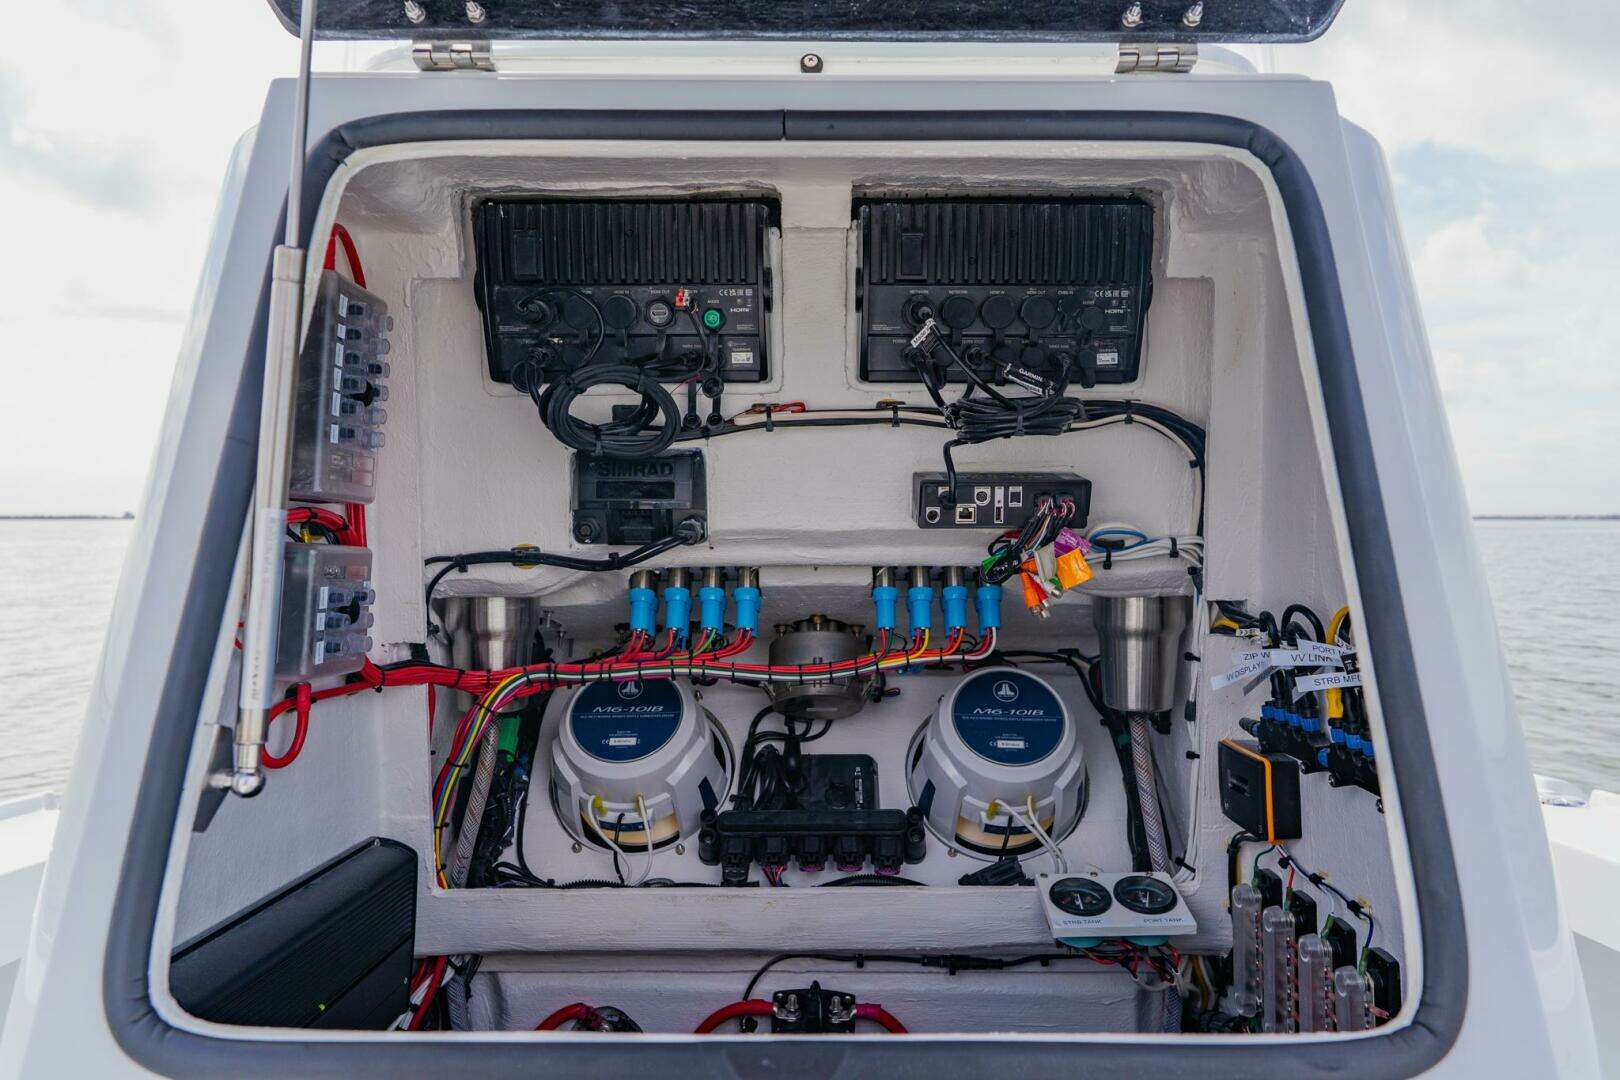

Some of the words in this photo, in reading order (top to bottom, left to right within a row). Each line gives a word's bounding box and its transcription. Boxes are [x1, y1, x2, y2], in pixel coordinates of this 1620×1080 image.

[1018, 368, 1043, 382] GARMIN
[1312, 645, 1336, 655] PORT
[1243, 653, 1258, 661] ZIP
[1313, 676, 1341, 687] STRB
